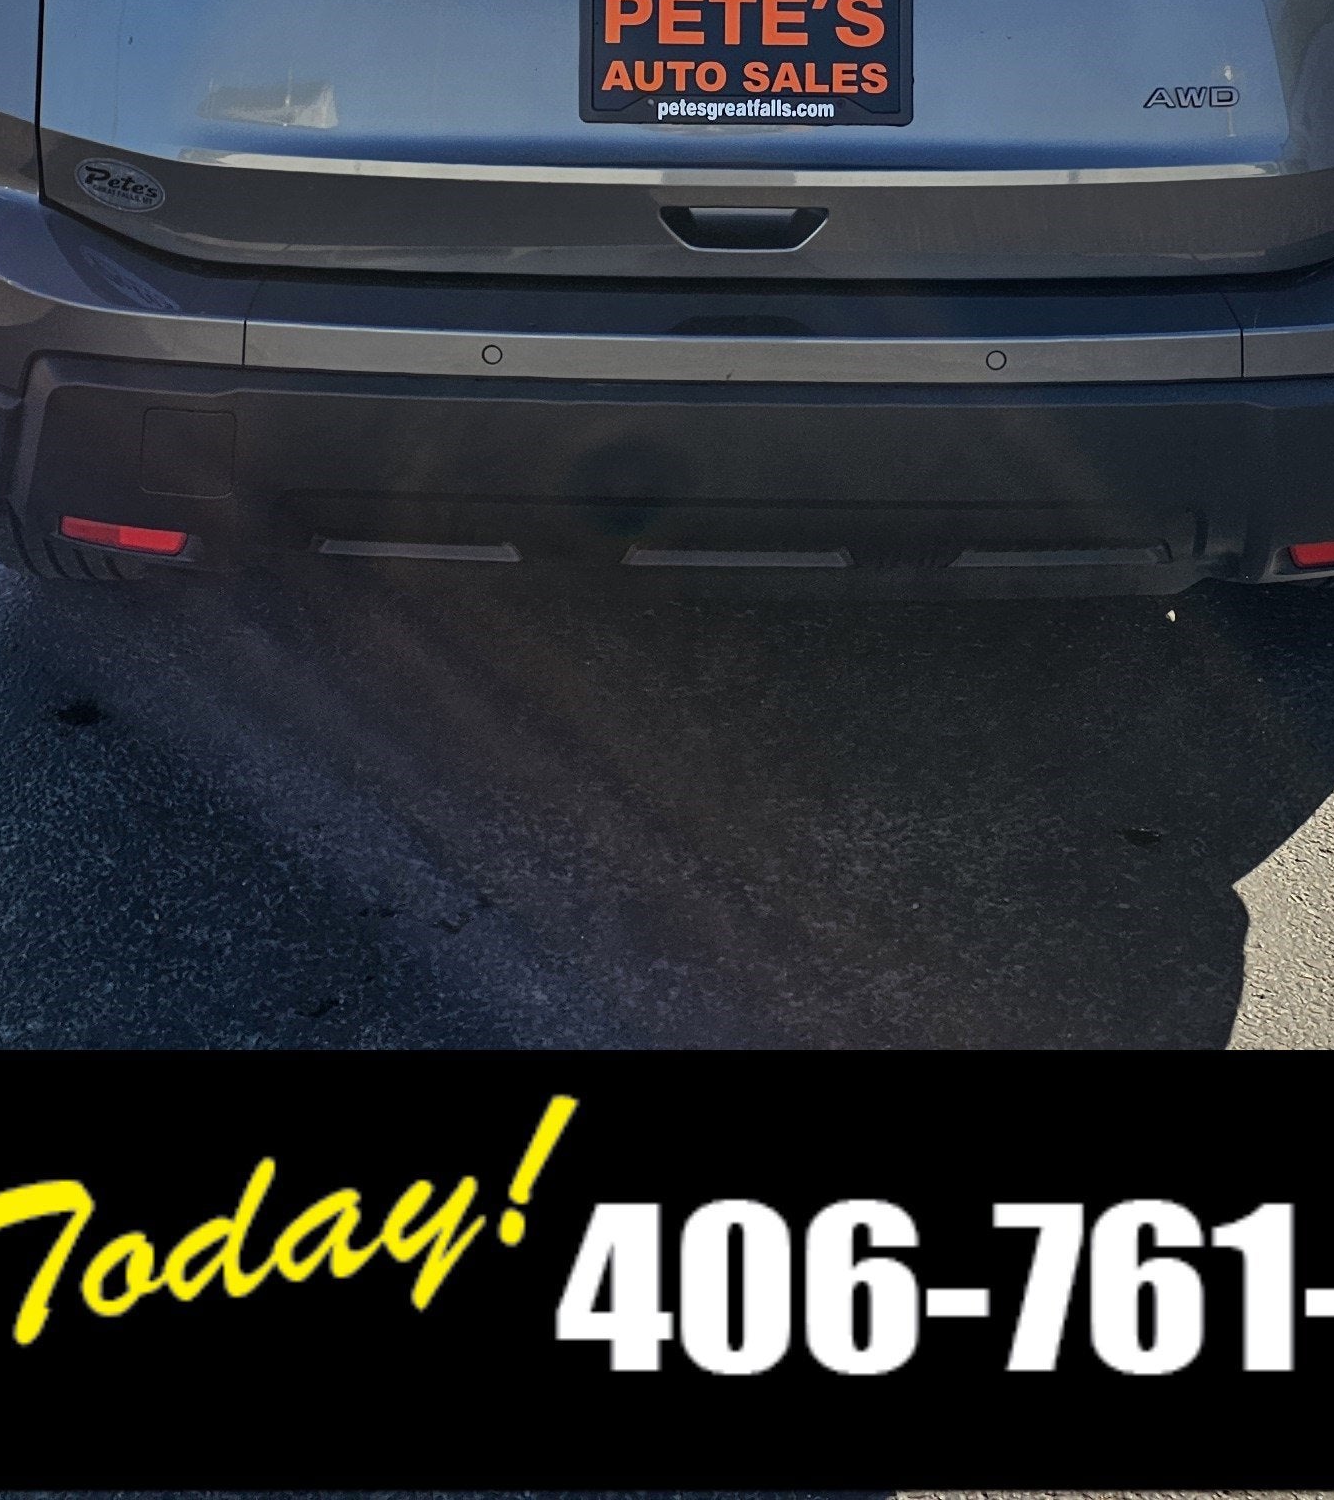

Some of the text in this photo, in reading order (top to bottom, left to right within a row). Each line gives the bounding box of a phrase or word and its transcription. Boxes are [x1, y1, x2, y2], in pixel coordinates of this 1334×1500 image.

[601, 60, 888, 94] AUTO SALES
[657, 99, 835, 120] petesgreatfalls.com
[1143, 86, 1240, 108] AWD
[84, 165, 158, 198] Pete's
